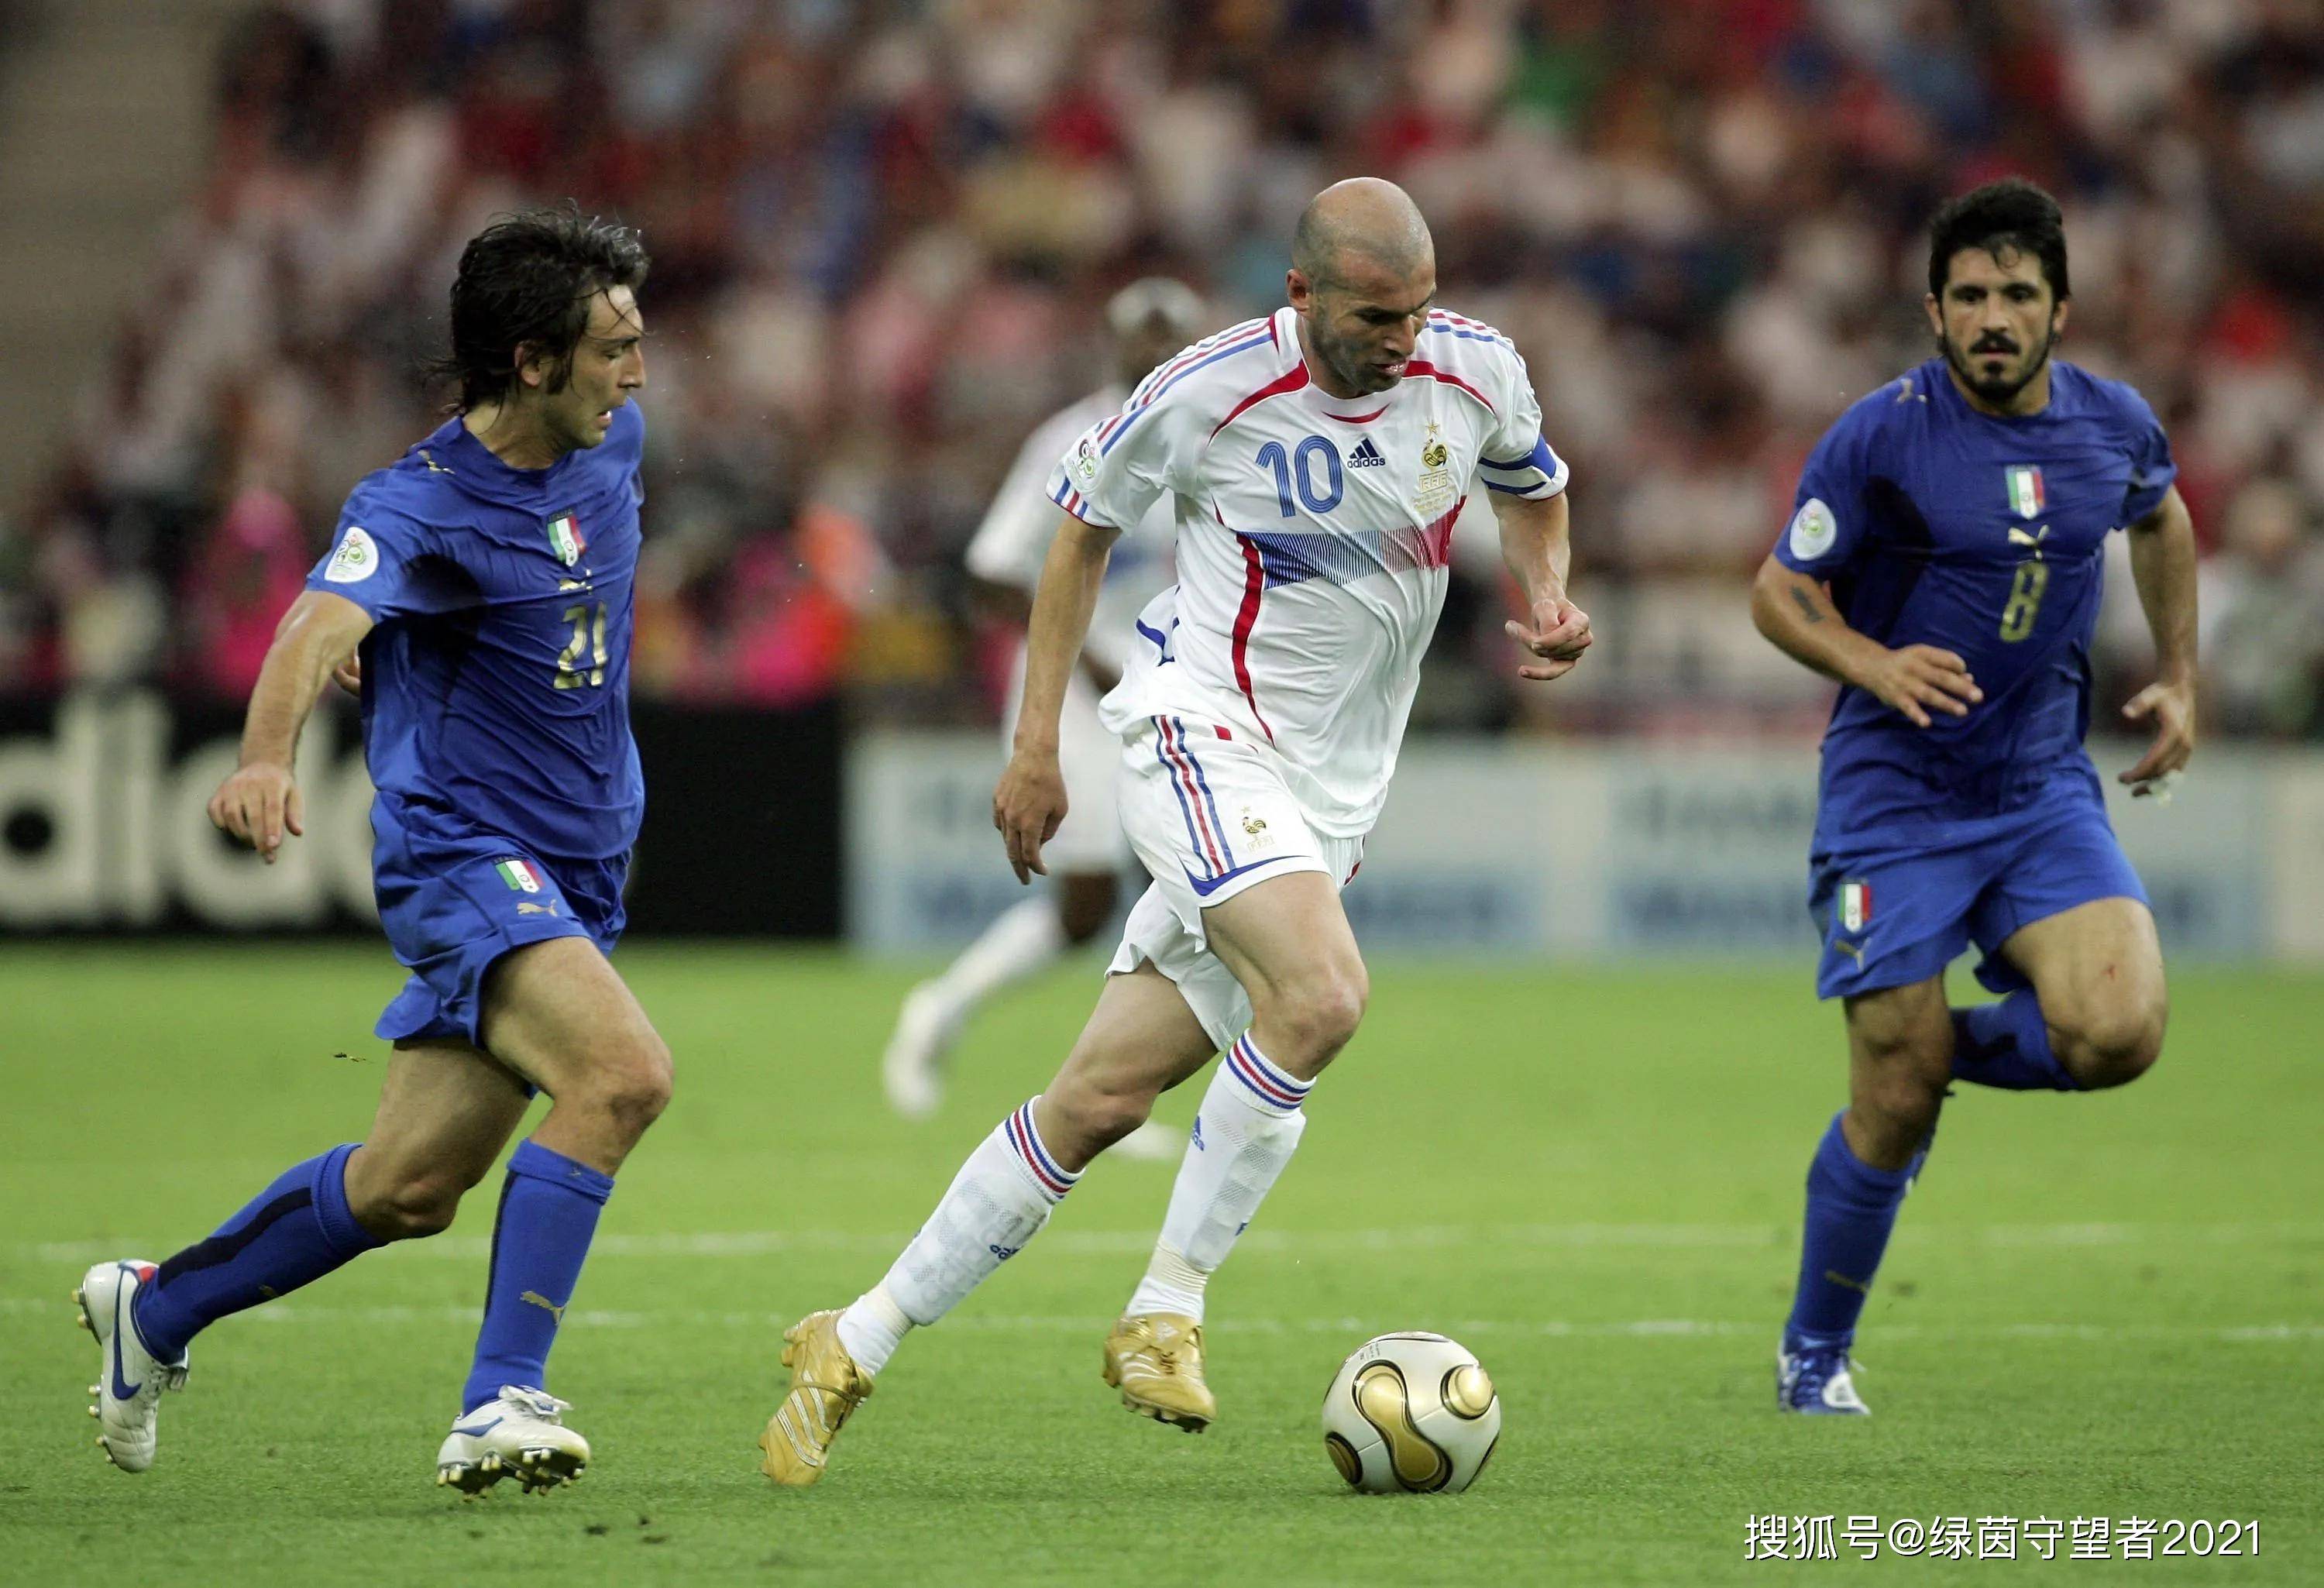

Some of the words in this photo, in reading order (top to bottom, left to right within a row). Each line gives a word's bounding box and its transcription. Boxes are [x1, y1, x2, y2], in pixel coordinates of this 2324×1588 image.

[1256, 435, 1343, 518] 10
[1347, 457, 1385, 468] adidas
[1999, 562, 2048, 641] 8
[553, 602, 607, 689] 21
